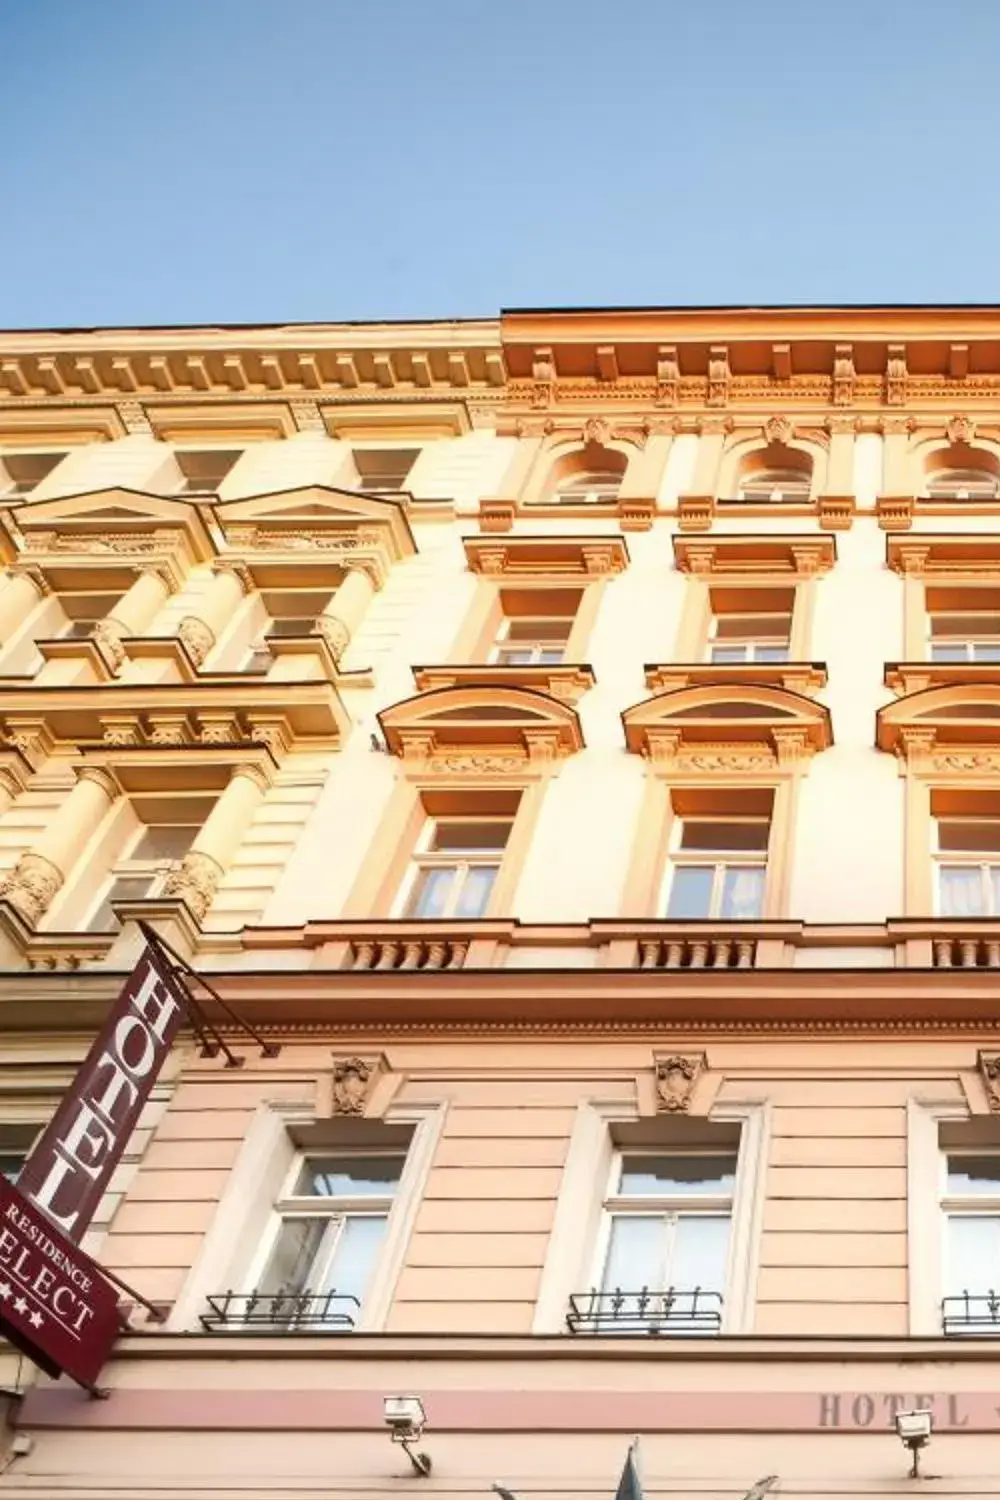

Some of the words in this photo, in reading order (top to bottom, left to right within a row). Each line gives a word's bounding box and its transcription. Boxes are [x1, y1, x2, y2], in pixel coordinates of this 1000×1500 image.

[28, 960, 181, 1232] HOTEL
[0, 1229, 95, 1332] ELECT
[5, 1203, 93, 1293] RESIDENCE
